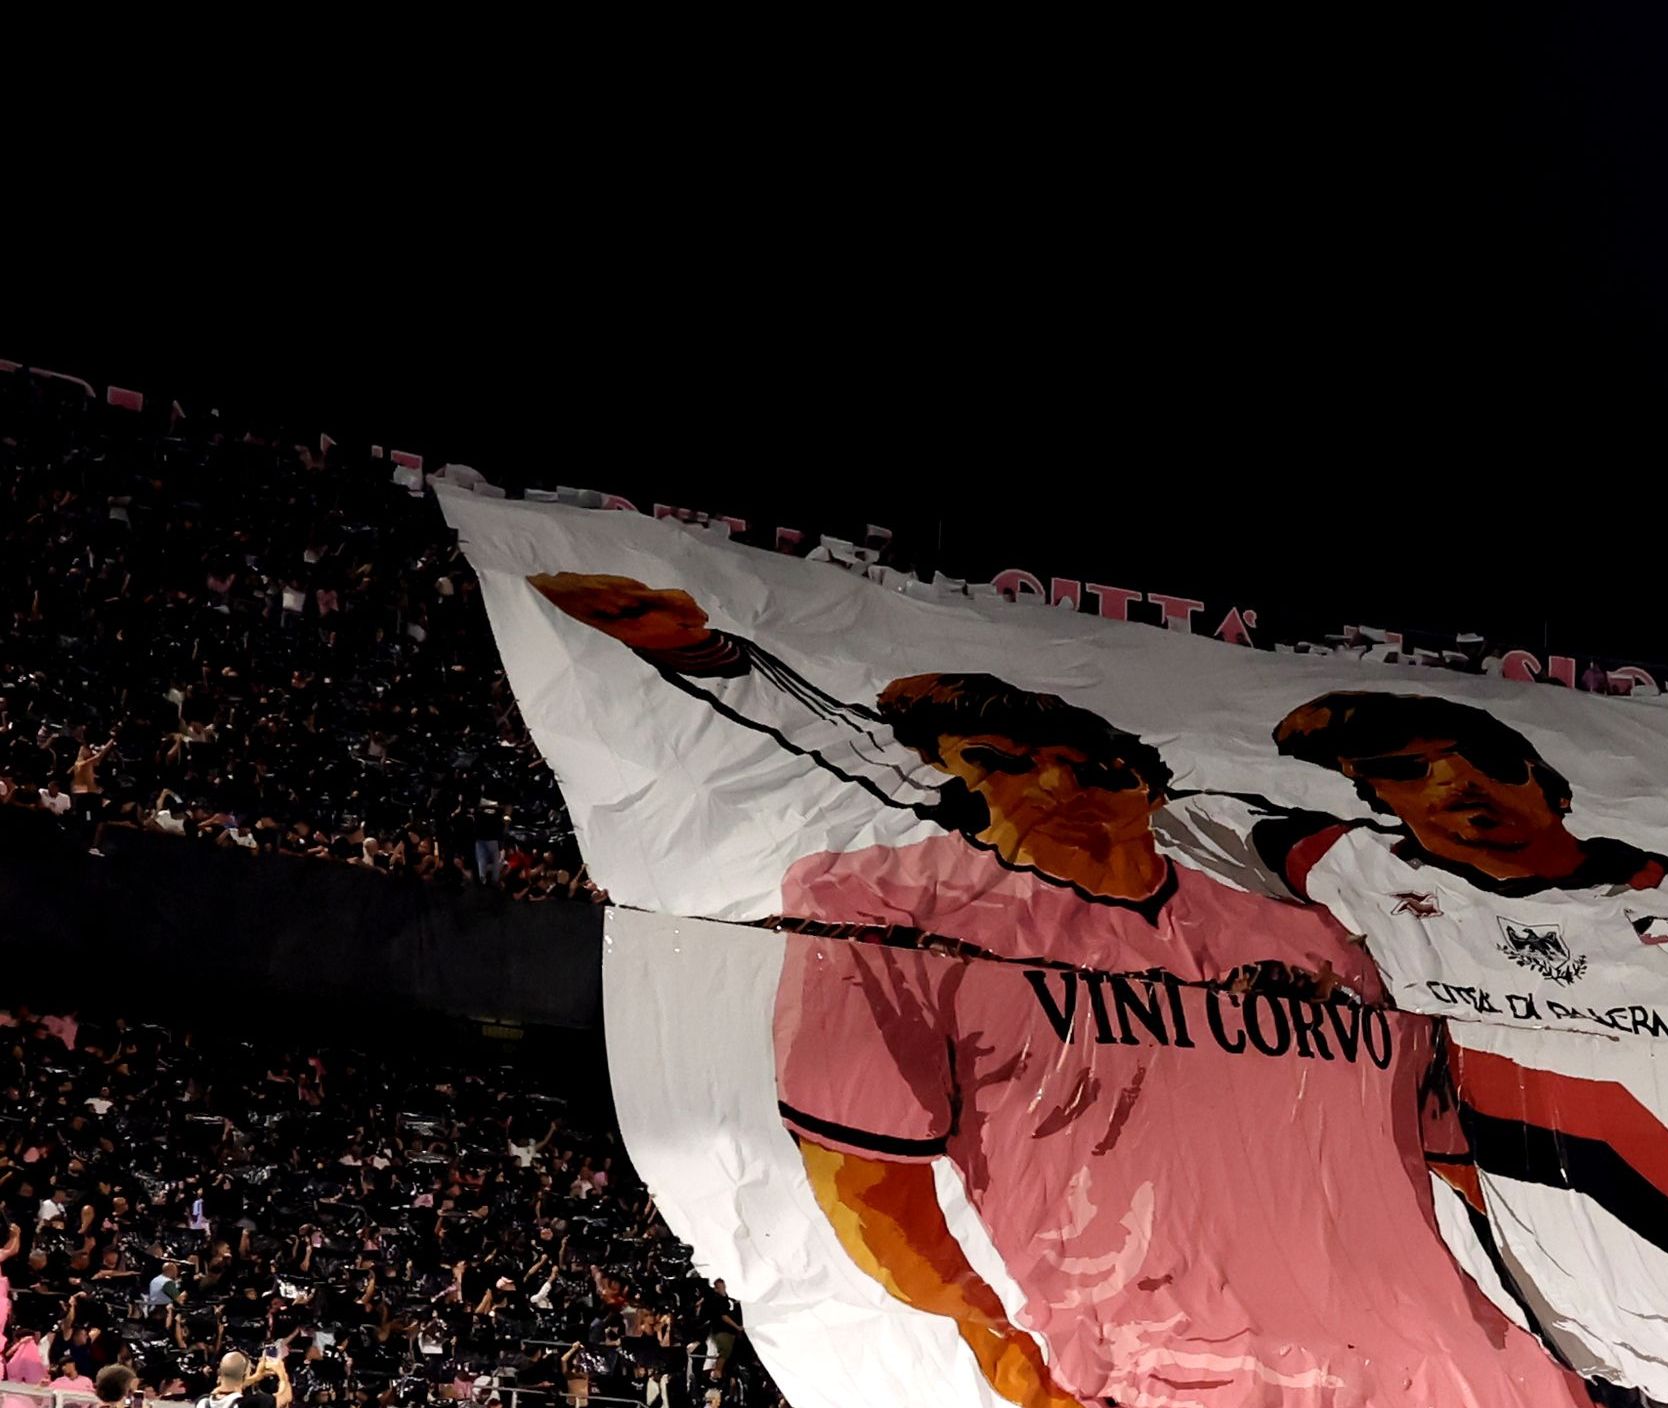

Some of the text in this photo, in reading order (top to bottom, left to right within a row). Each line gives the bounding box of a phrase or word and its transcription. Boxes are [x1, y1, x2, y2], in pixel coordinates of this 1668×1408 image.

[1023, 968, 1392, 1069] VINI CORVO
[1505, 993, 1542, 1020] DI
